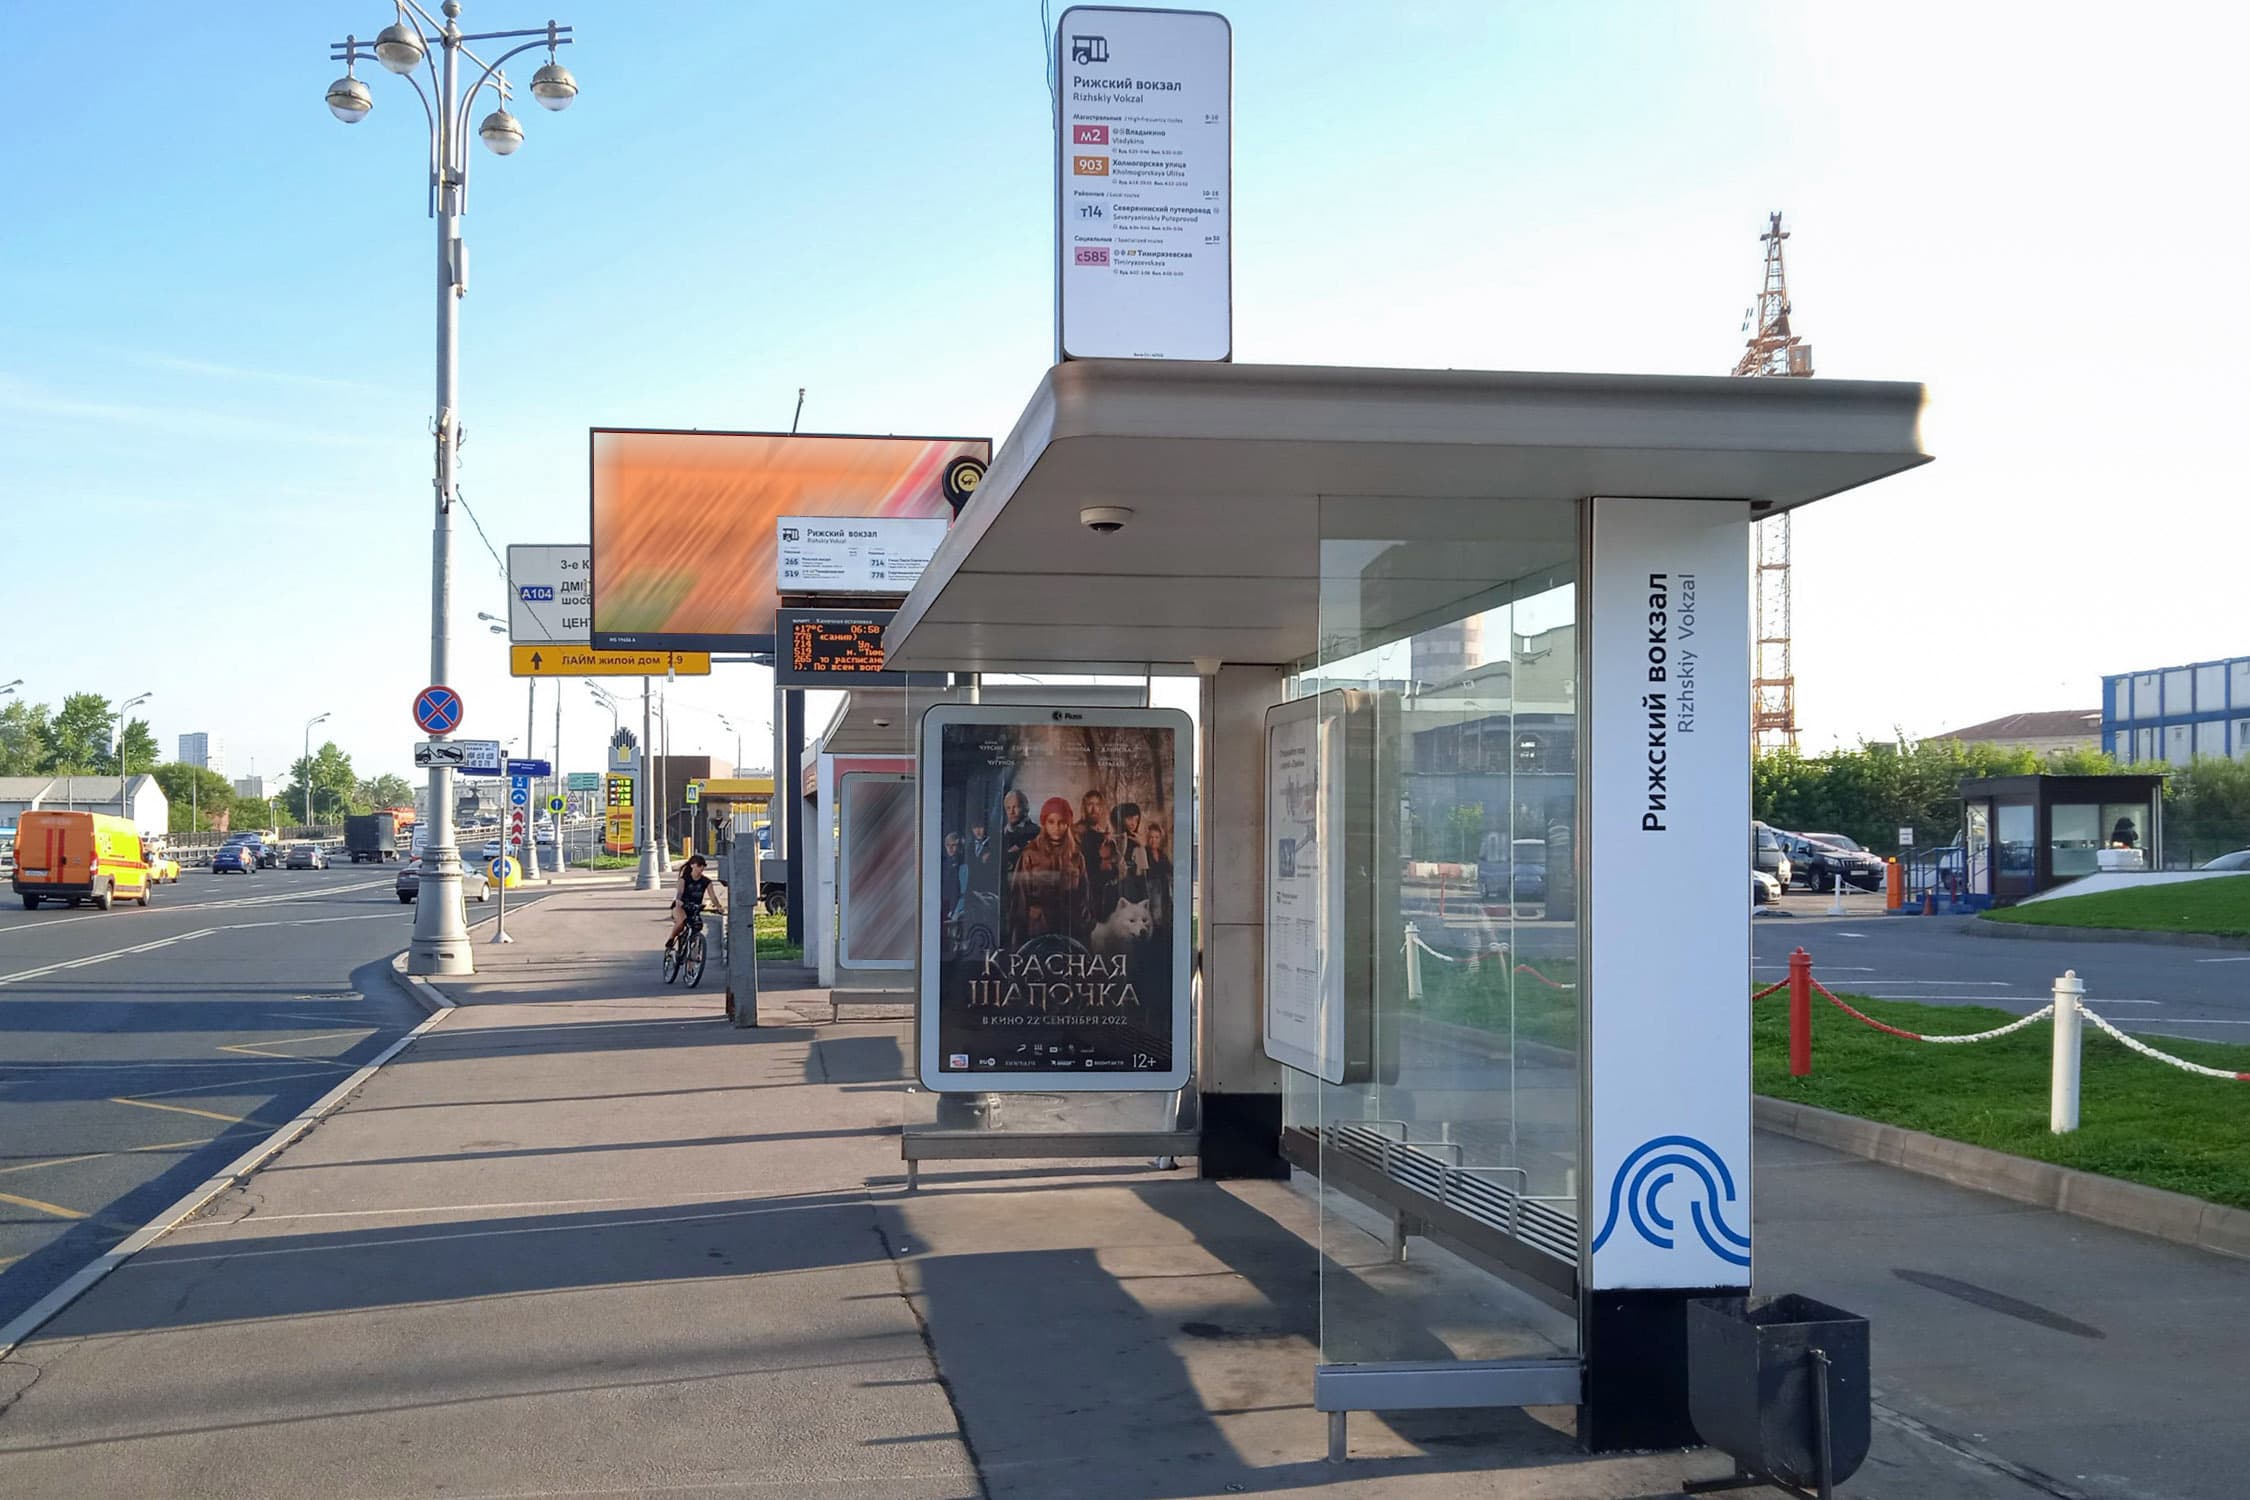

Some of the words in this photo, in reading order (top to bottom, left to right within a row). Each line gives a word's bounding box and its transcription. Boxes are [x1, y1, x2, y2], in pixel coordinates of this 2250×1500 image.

[1073, 76, 1133, 90] Рижский
[1136, 80, 1182, 92] вокзал
[1073, 92, 1111, 104] Rizhskiy
[1113, 94, 1144, 103] Vokzal
[1079, 159, 1103, 171] 903
[1080, 206, 1103, 218] т14
[1076, 251, 1107, 263] с585
[807, 528, 845, 538] Рижский
[560, 560, 579, 570] 3-е
[785, 557, 799, 566] 265
[871, 559, 885, 567] 714
[871, 571, 885, 579] 778
[1677, 573, 1695, 641] Vokzal
[851, 625, 880, 633] 06:58
[1648, 573, 1668, 683] вокзал
[794, 632, 812, 640] 778
[794, 640, 812, 648] 714
[794, 647, 812, 655] 519
[562, 654, 596, 665] ЛАЙМ
[599, 655, 636, 665] жилой
[638, 657, 661, 666] дом
[1677, 650, 1698, 733] Rizhskiy
[1641, 693, 1667, 832] Рижский
[981, 949, 1127, 979] КРАСНАЯ
[968, 980, 1140, 1012] ШАПОЧКА
[982, 1016, 989, 1025] В
[991, 1016, 1024, 1025] КИНО
[1027, 1016, 1040, 1025] 22
[1042, 1016, 1099, 1025] СЕНТЯБРЯ
[1102, 1016, 1128, 1025] 2022
[1133, 1053, 1157, 1068] 12+
